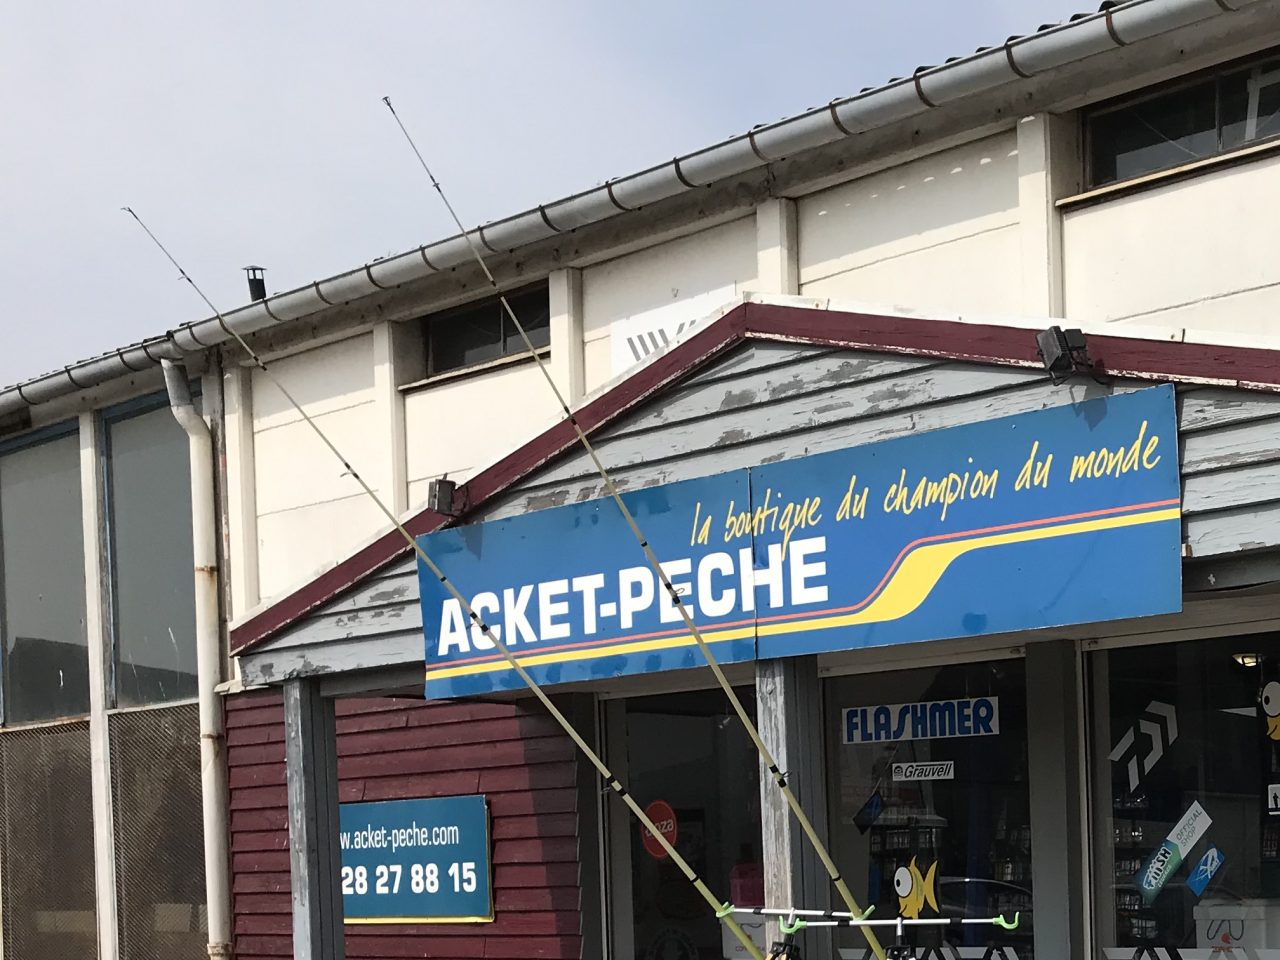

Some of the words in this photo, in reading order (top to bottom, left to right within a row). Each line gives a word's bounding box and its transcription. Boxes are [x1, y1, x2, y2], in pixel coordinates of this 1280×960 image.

[689, 502, 710, 546] la
[724, 488, 823, 561] boutique
[836, 474, 871, 523] du
[883, 456, 999, 521] champion
[1014, 440, 1054, 492] du
[1069, 420, 1162, 483] monde
[437, 535, 829, 657] ACKET-PECHE
[846, 698, 994, 743] FLASHMER
[904, 764, 952, 780] Grauvell
[1176, 809, 1203, 841] OFFICIAL
[1181, 826, 1196, 847] SHOP
[340, 865, 368, 895] 28
[375, 864, 402, 894] 27
[410, 863, 439, 893] 88
[448, 862, 477, 892] 15
